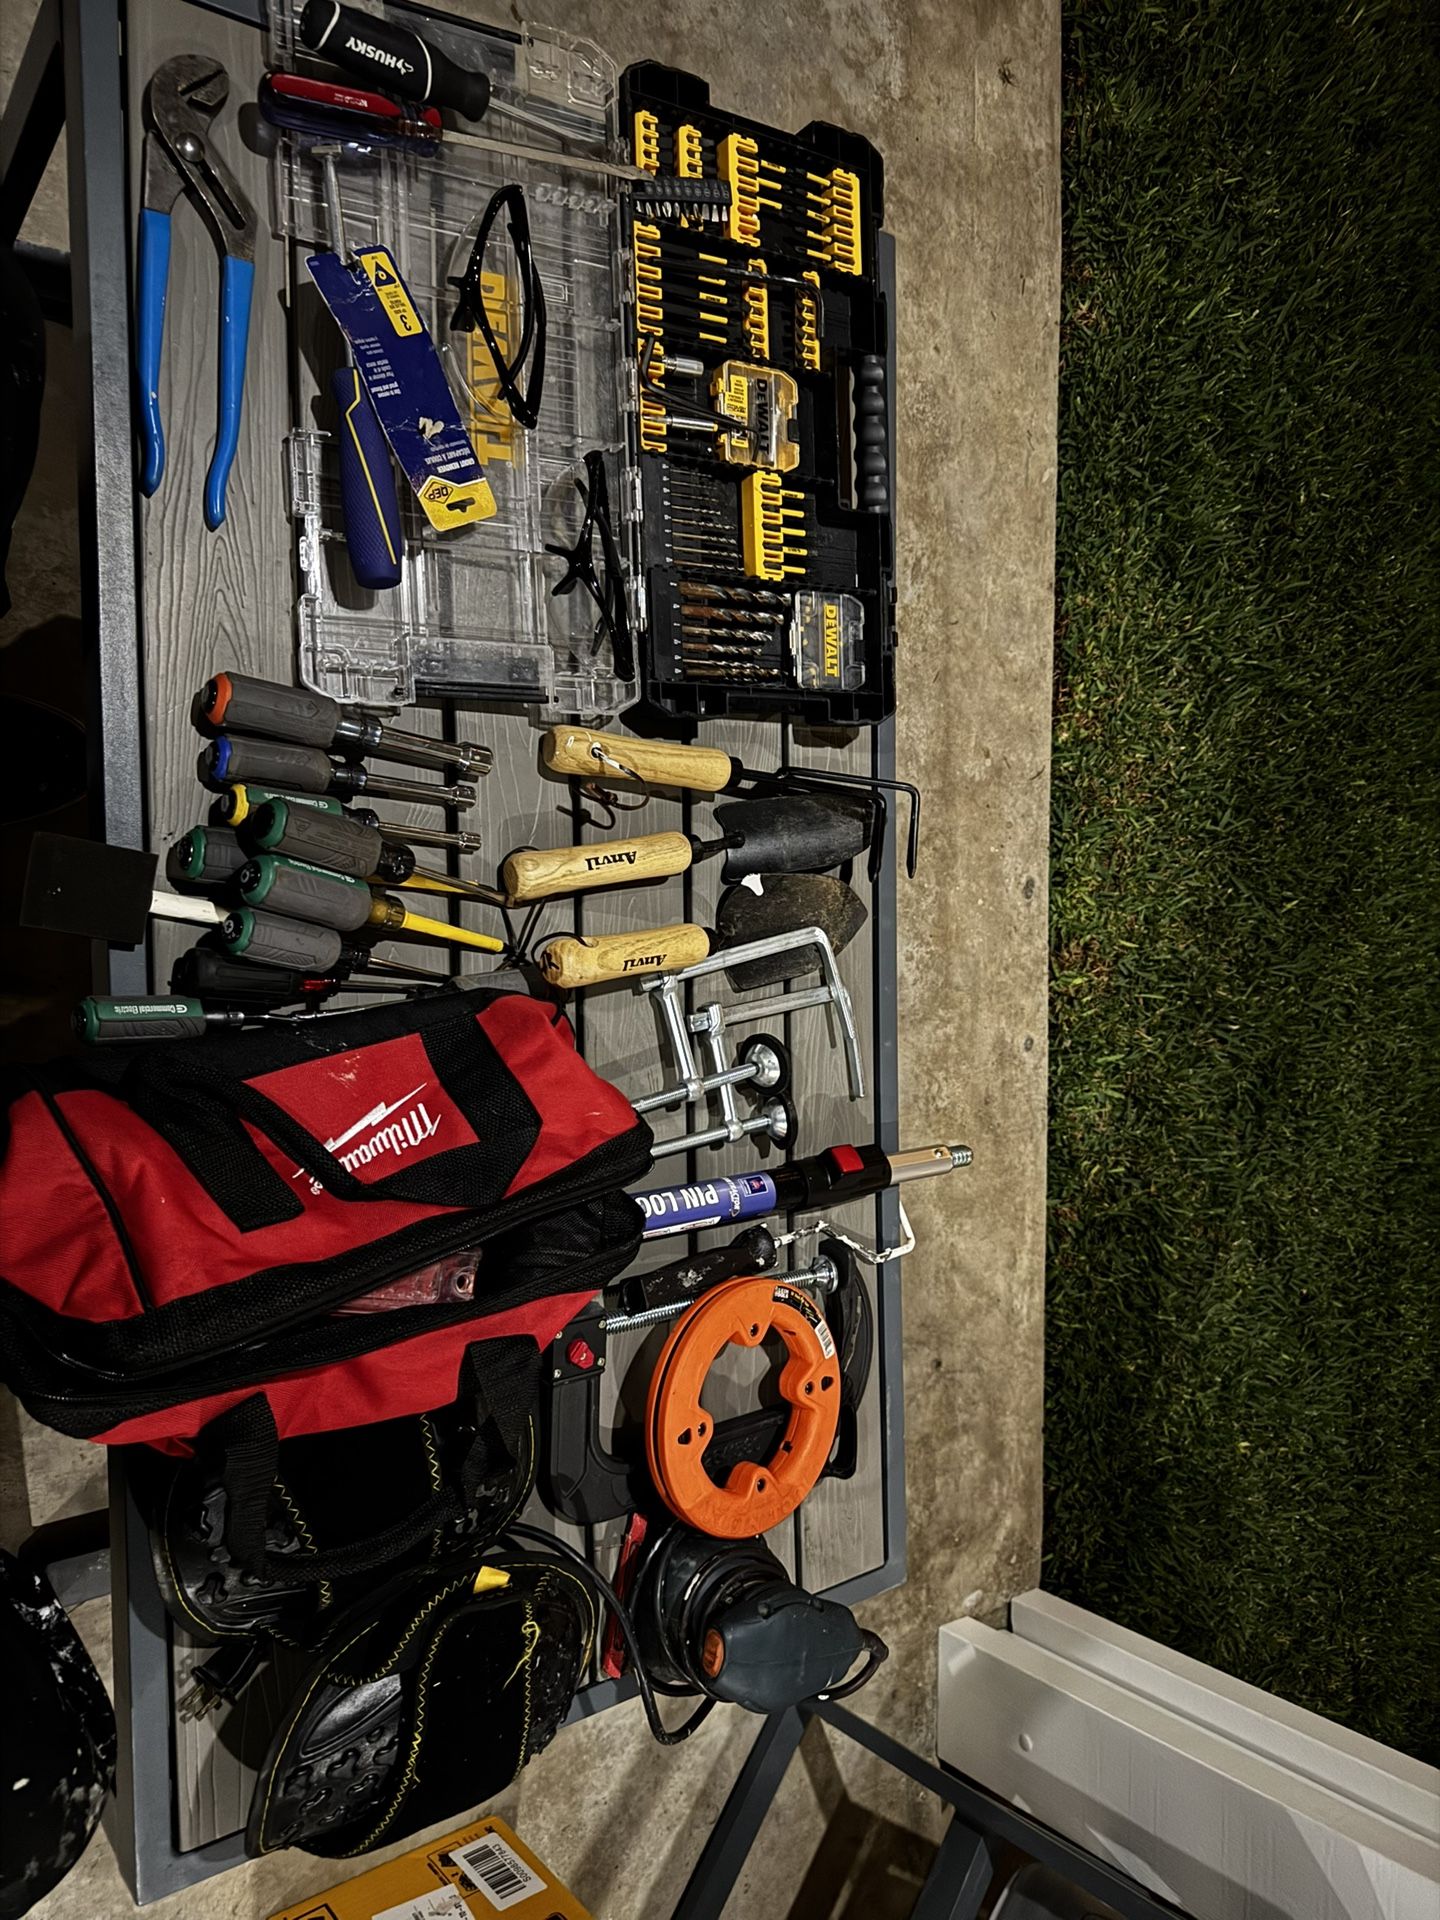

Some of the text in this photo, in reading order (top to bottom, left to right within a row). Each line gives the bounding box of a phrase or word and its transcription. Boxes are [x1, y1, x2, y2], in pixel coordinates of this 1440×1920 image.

[345, 36, 397, 68] HUSKY
[400, 314, 411, 331] 3
[757, 379, 769, 454] DEWALT
[428, 486, 449, 500] QEP
[825, 604, 839, 677] DEWALT
[585, 851, 637, 871] Anvil
[622, 954, 667, 971] Anvil
[113, 1004, 176, 1015] Commercial Electric
[292, 1103, 441, 1182] Milwau
[635, 1191, 679, 1218] LOC
[680, 1184, 719, 1210] PIN
